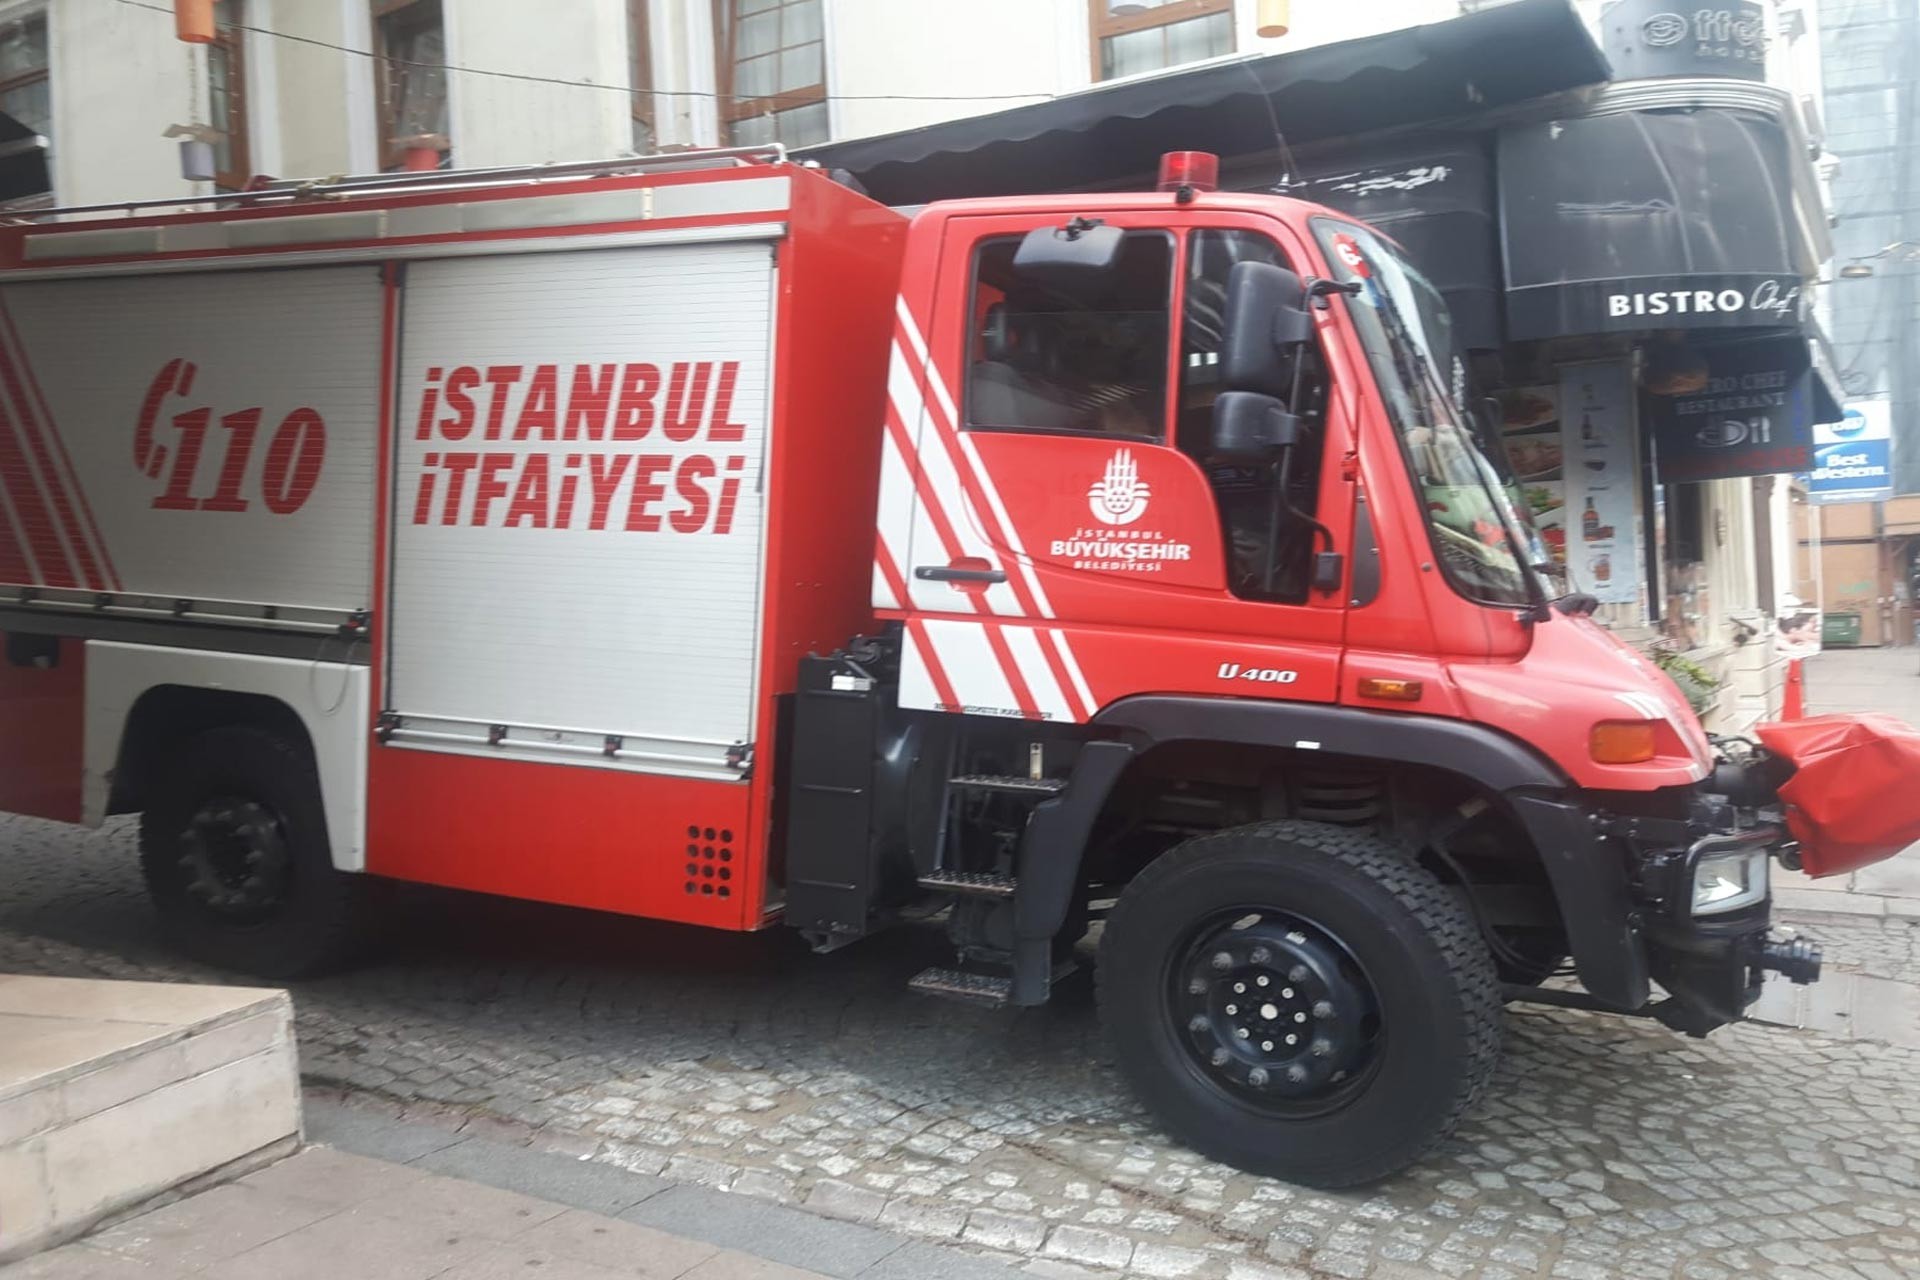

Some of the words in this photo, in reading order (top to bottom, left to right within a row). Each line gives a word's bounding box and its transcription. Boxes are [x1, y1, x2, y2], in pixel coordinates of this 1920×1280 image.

[1609, 289, 1745, 316] BISTRO
[1676, 392, 1786, 415] RESTAURANT
[151, 406, 326, 515] 110
[1826, 454, 1868, 467] Best
[1050, 537, 1191, 562] BÜYÜKŞEHİR
